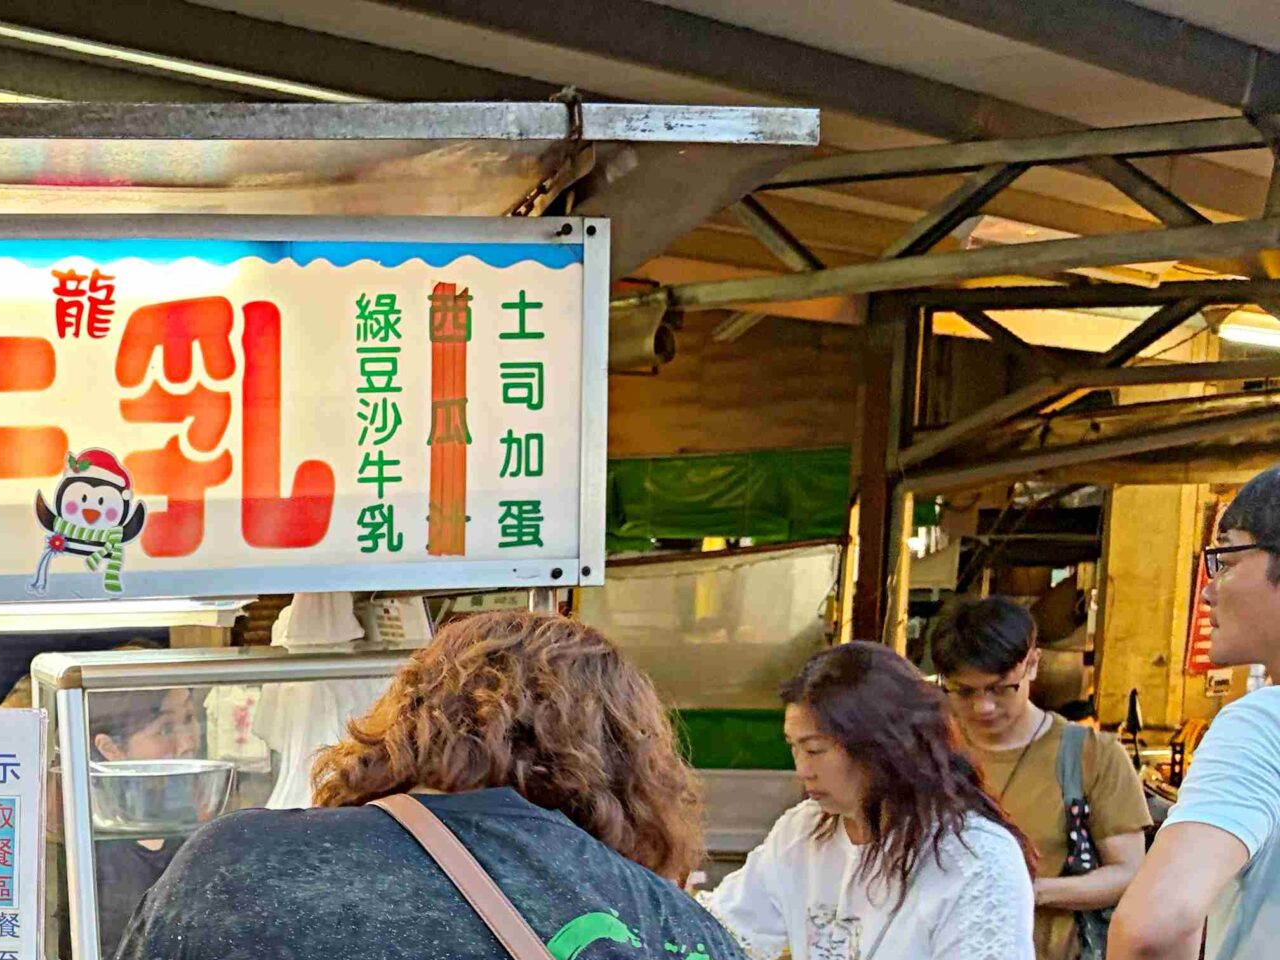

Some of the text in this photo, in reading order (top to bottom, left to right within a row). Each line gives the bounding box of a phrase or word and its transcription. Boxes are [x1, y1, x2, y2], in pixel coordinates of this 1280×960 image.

[355, 292, 404, 554] 綠豆沙牛乳
[497, 289, 545, 549] 土司加蛋
